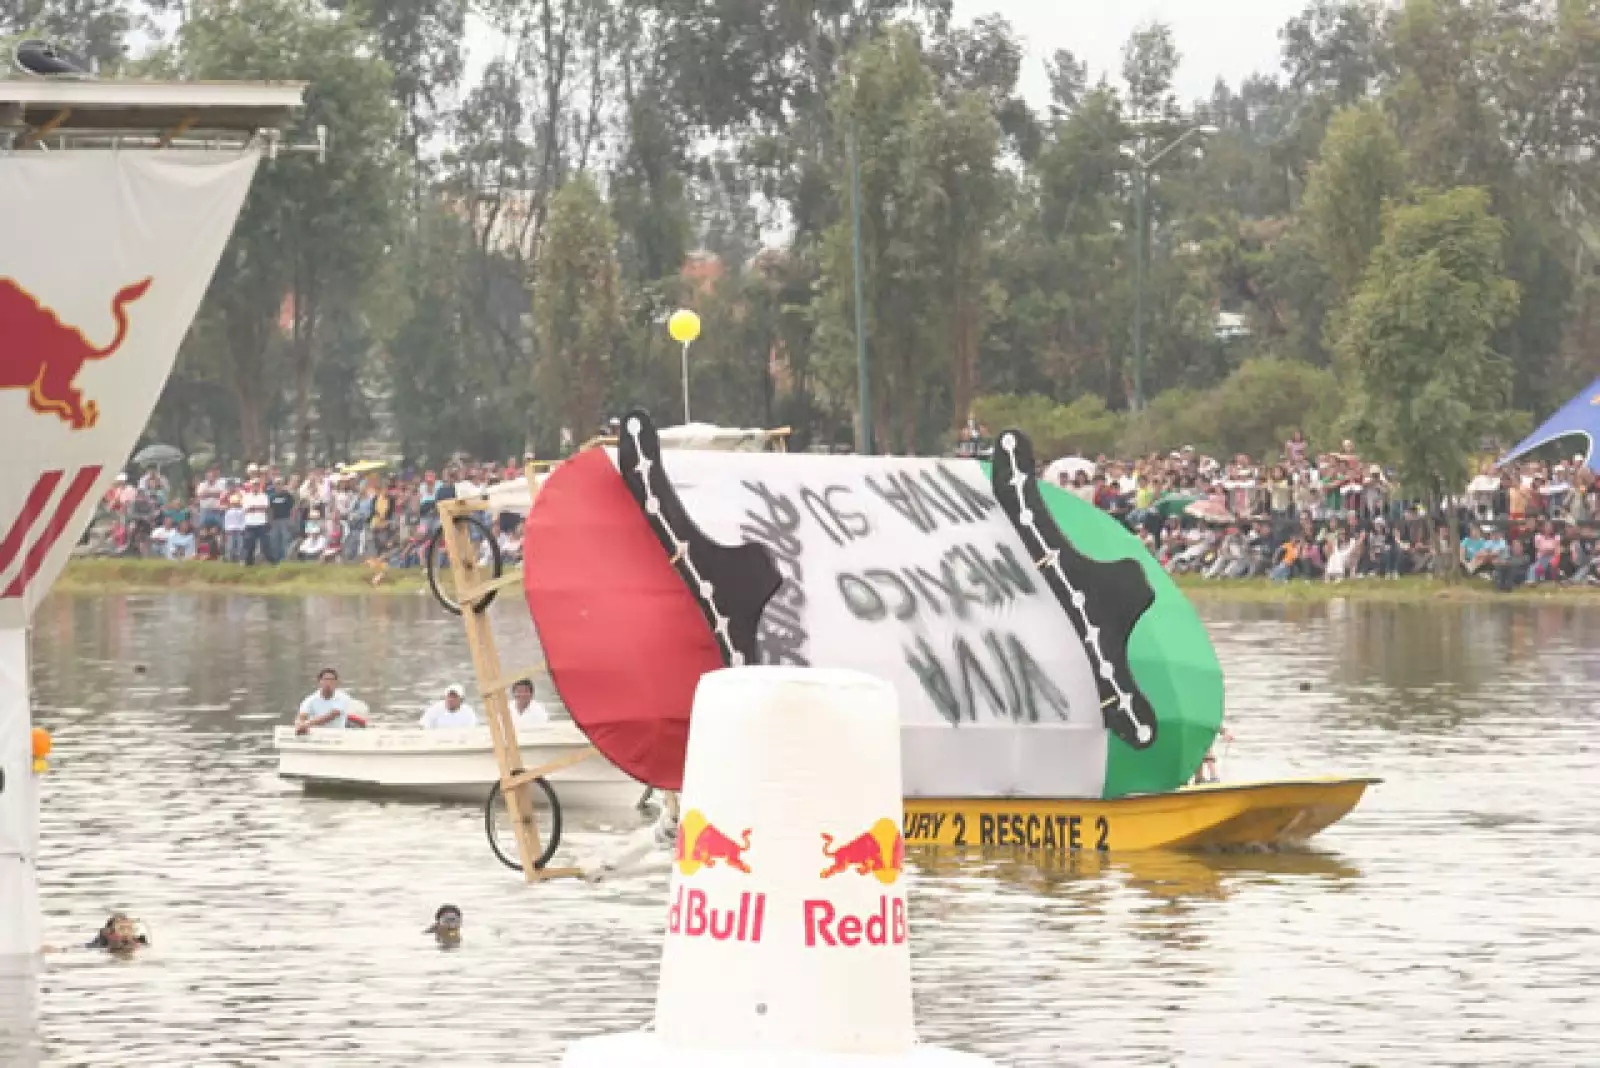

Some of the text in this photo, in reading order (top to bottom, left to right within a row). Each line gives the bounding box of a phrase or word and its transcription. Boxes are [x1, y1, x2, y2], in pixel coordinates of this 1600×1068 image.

[800, 461, 997, 546] VIVA SU
[837, 542, 1037, 621] MEXICO
[903, 630, 1068, 727] VIVA
[952, 812, 967, 847] 2
[979, 812, 1082, 850] RESCATE
[1095, 814, 1109, 851] 2
